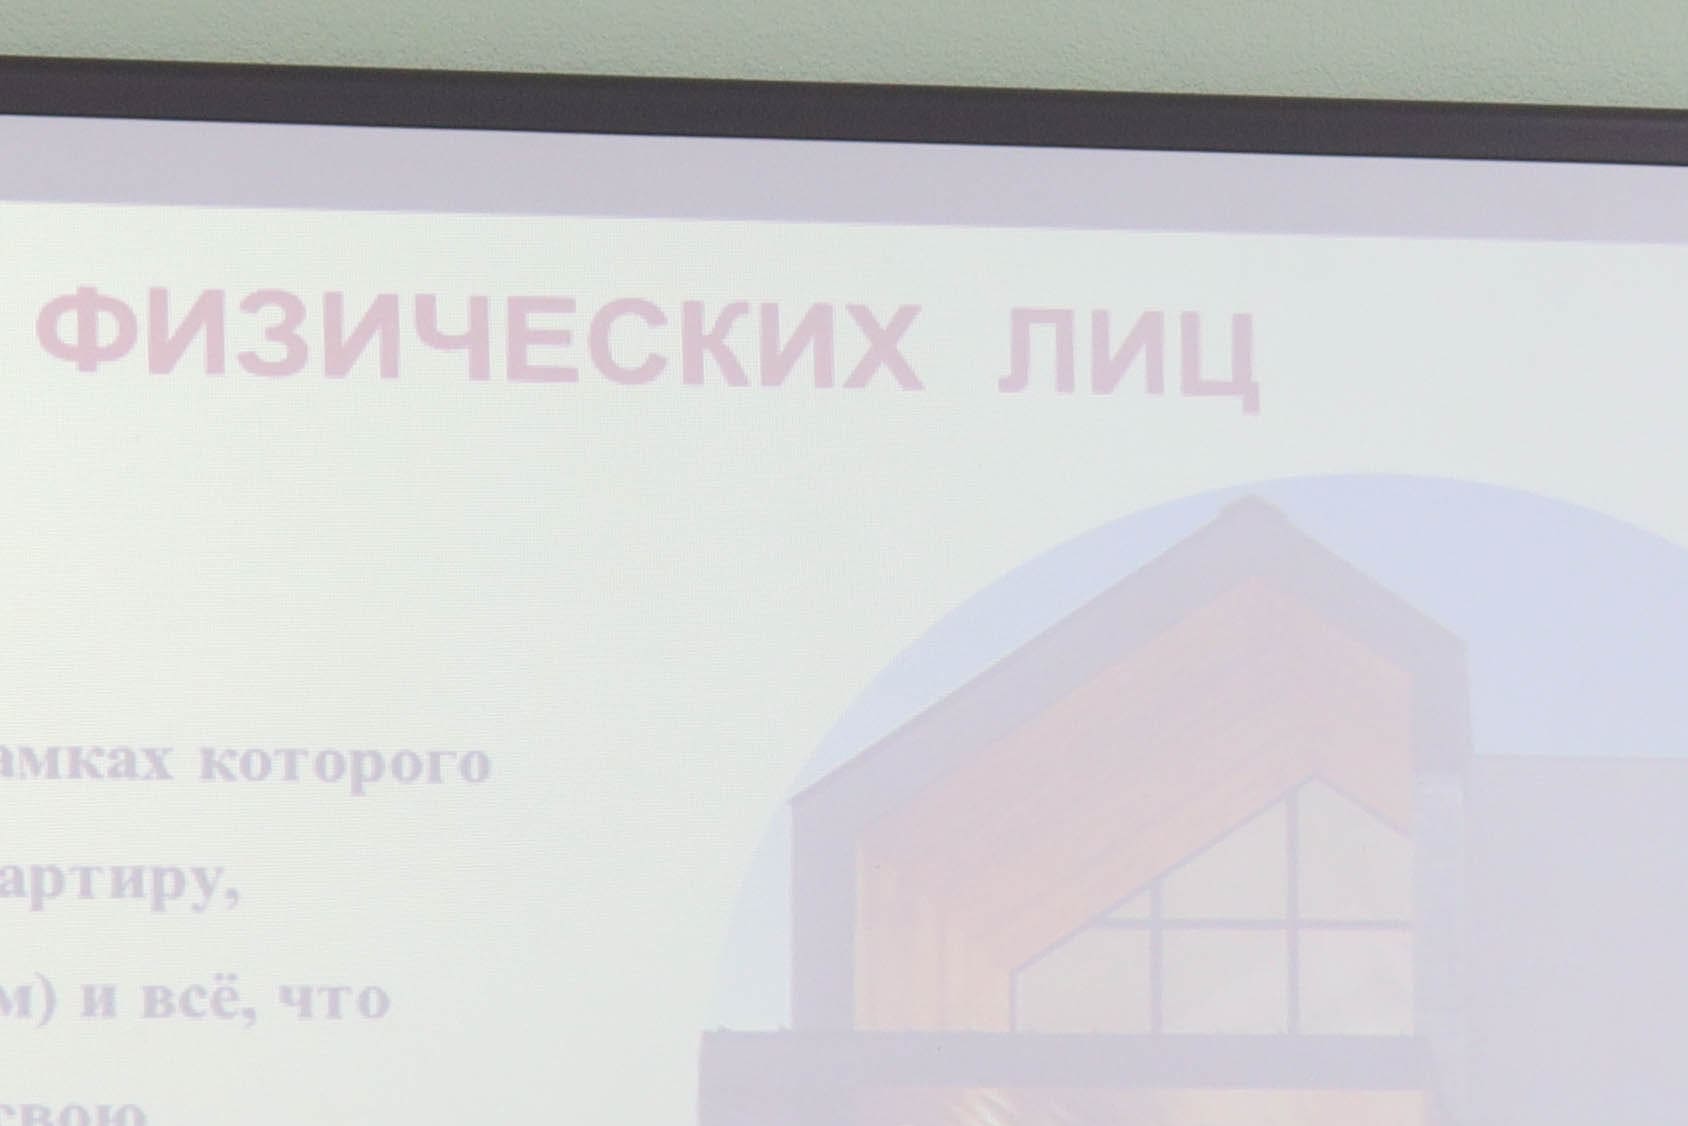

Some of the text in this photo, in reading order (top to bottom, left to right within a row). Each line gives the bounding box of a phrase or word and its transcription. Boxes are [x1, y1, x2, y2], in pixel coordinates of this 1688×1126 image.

[35, 286, 1261, 415] ФИЗИЧЕСКИХ ЛИЦ
[199, 746, 491, 796] которого
[80, 983, 119, 1020] и
[142, 972, 257, 1028] всё,
[277, 984, 392, 1021] что
